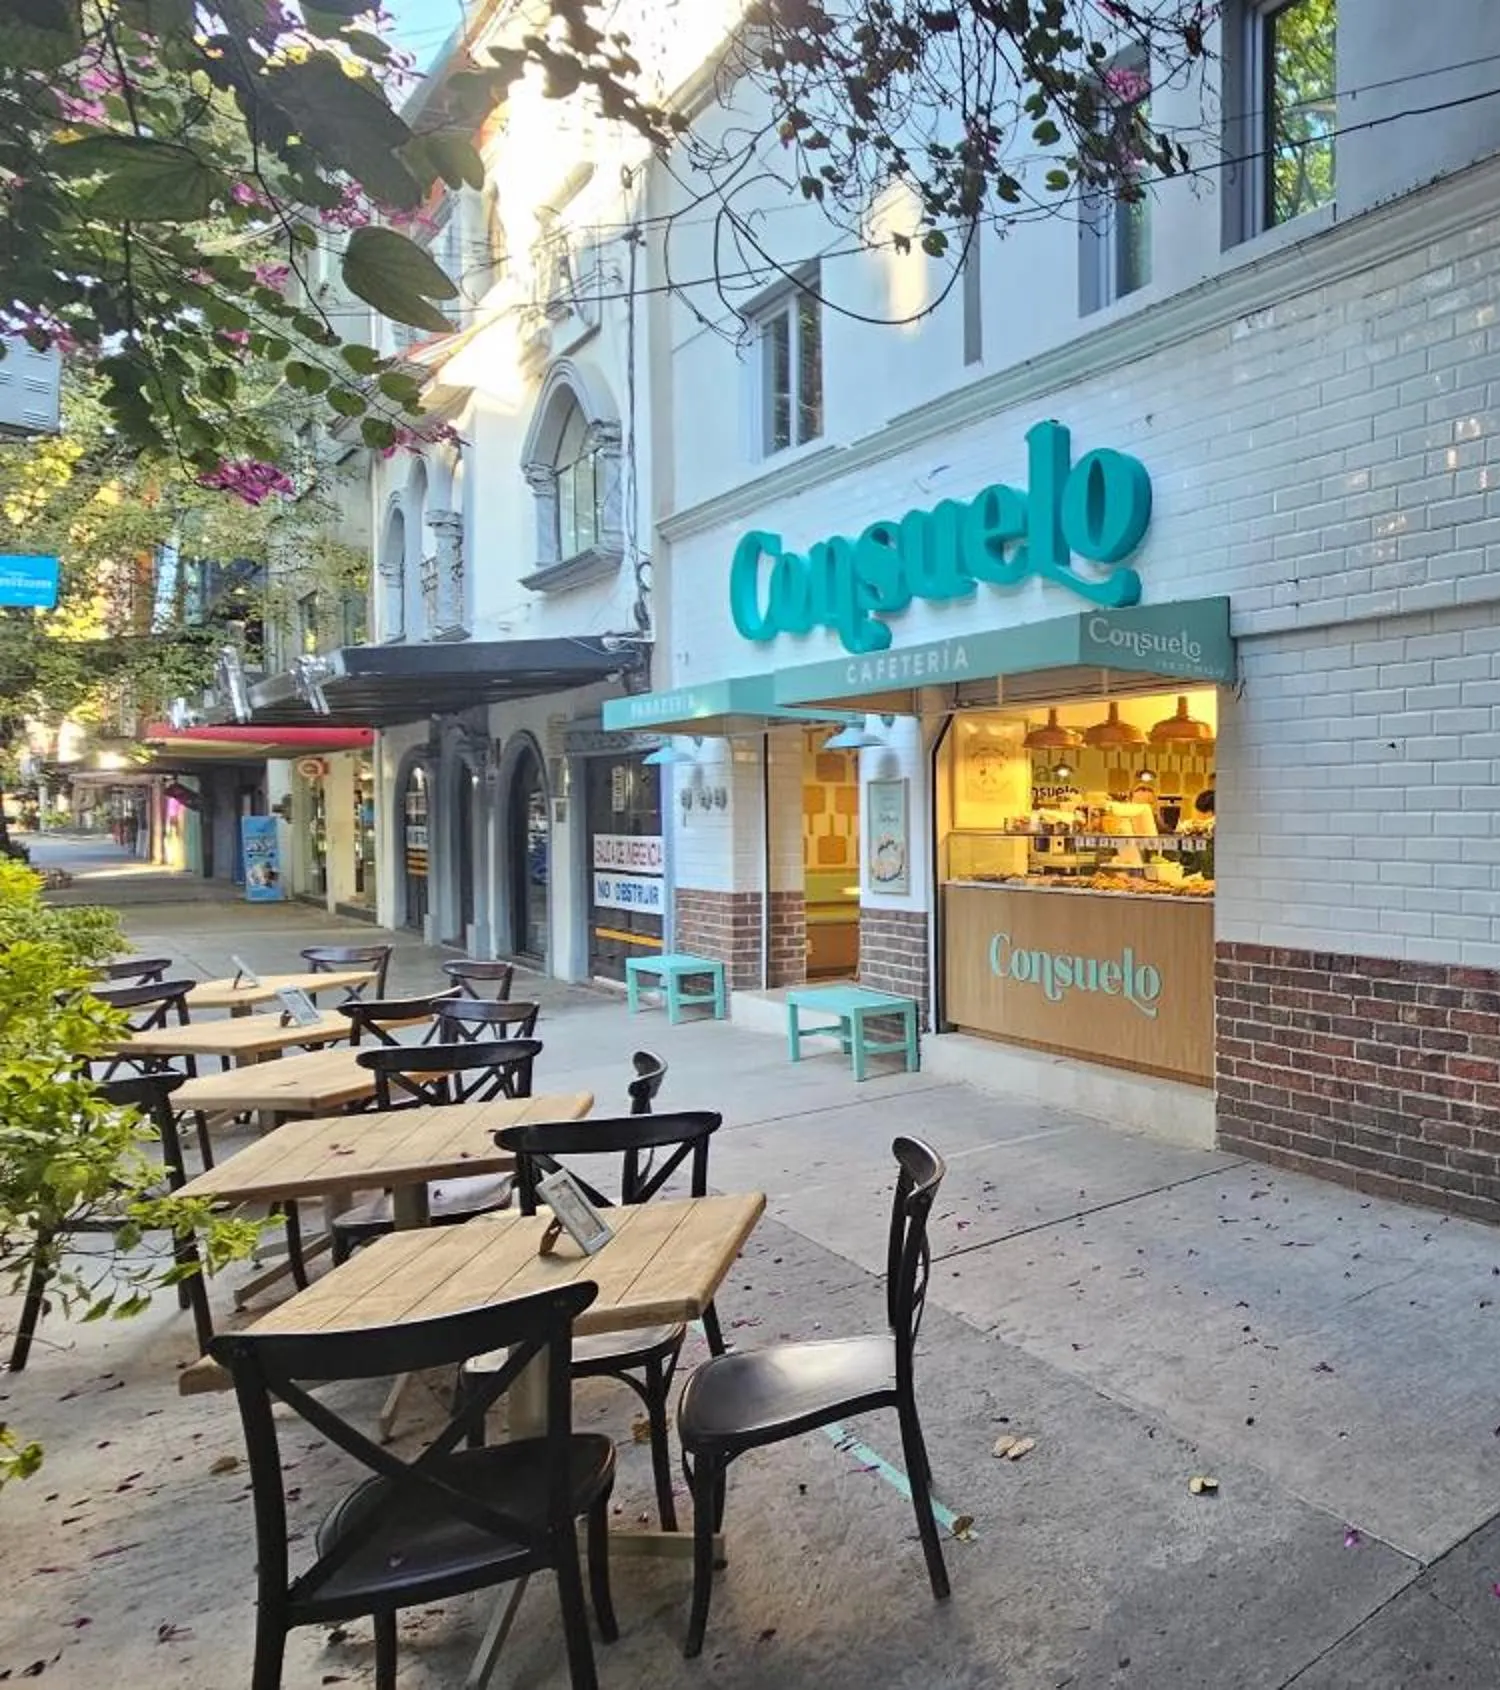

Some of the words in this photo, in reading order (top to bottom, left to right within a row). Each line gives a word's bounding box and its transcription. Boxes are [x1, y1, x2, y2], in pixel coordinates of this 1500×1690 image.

[730, 419, 1153, 655] Consuelo
[846, 640, 969, 684] CAFETERÍA
[1089, 617, 1201, 662] Consuelo
[597, 880, 611, 898] NO
[990, 932, 1162, 1018] Consuelo
